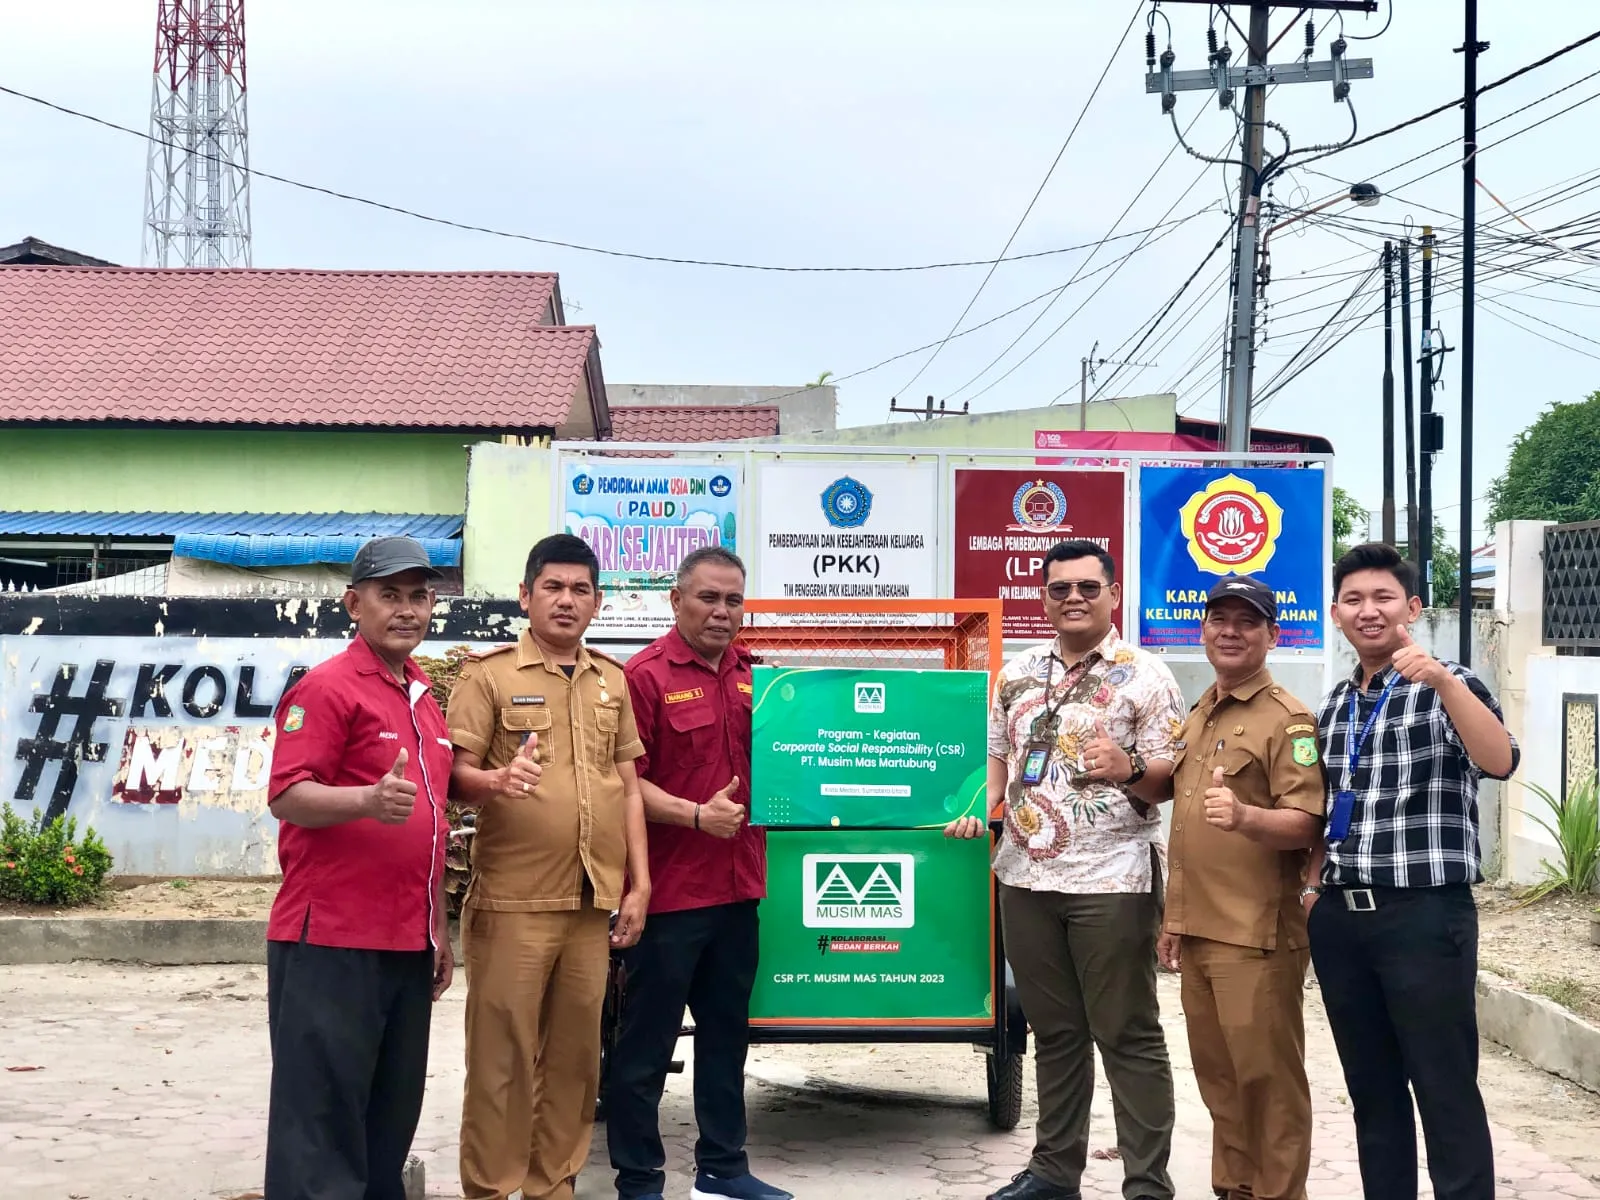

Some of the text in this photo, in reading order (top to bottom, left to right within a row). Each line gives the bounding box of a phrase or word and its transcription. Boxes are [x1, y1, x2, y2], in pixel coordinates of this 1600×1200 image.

[598, 477, 706, 495] PENDIDIKAN ANAK USIA DINI
[629, 500, 676, 518] PAUD
[769, 534, 925, 549] PEMBERDAYAAN DAN KESEJAHTERAAN KELUARGA
[969, 535, 1002, 551] LEMBAGA
[813, 554, 880, 579] (PKK)
[1005, 556, 1044, 581] (LP
[784, 584, 910, 598] TIM PENGGERAK PKK KELURAHAN TANGKAHAN
[1166, 589, 1208, 603] KARA
[817, 728, 863, 742] Program
[873, 728, 920, 743] Kegiatan
[772, 741, 965, 758] Corporate Social Responsibility (CSR)
[124, 736, 275, 792] MED
[801, 755, 937, 772] PT. Musim Mas Martubung
[816, 906, 903, 918] MUSIM MAS
[773, 973, 945, 983] CSR PT. MUSIM MAS TAHUN 2023
